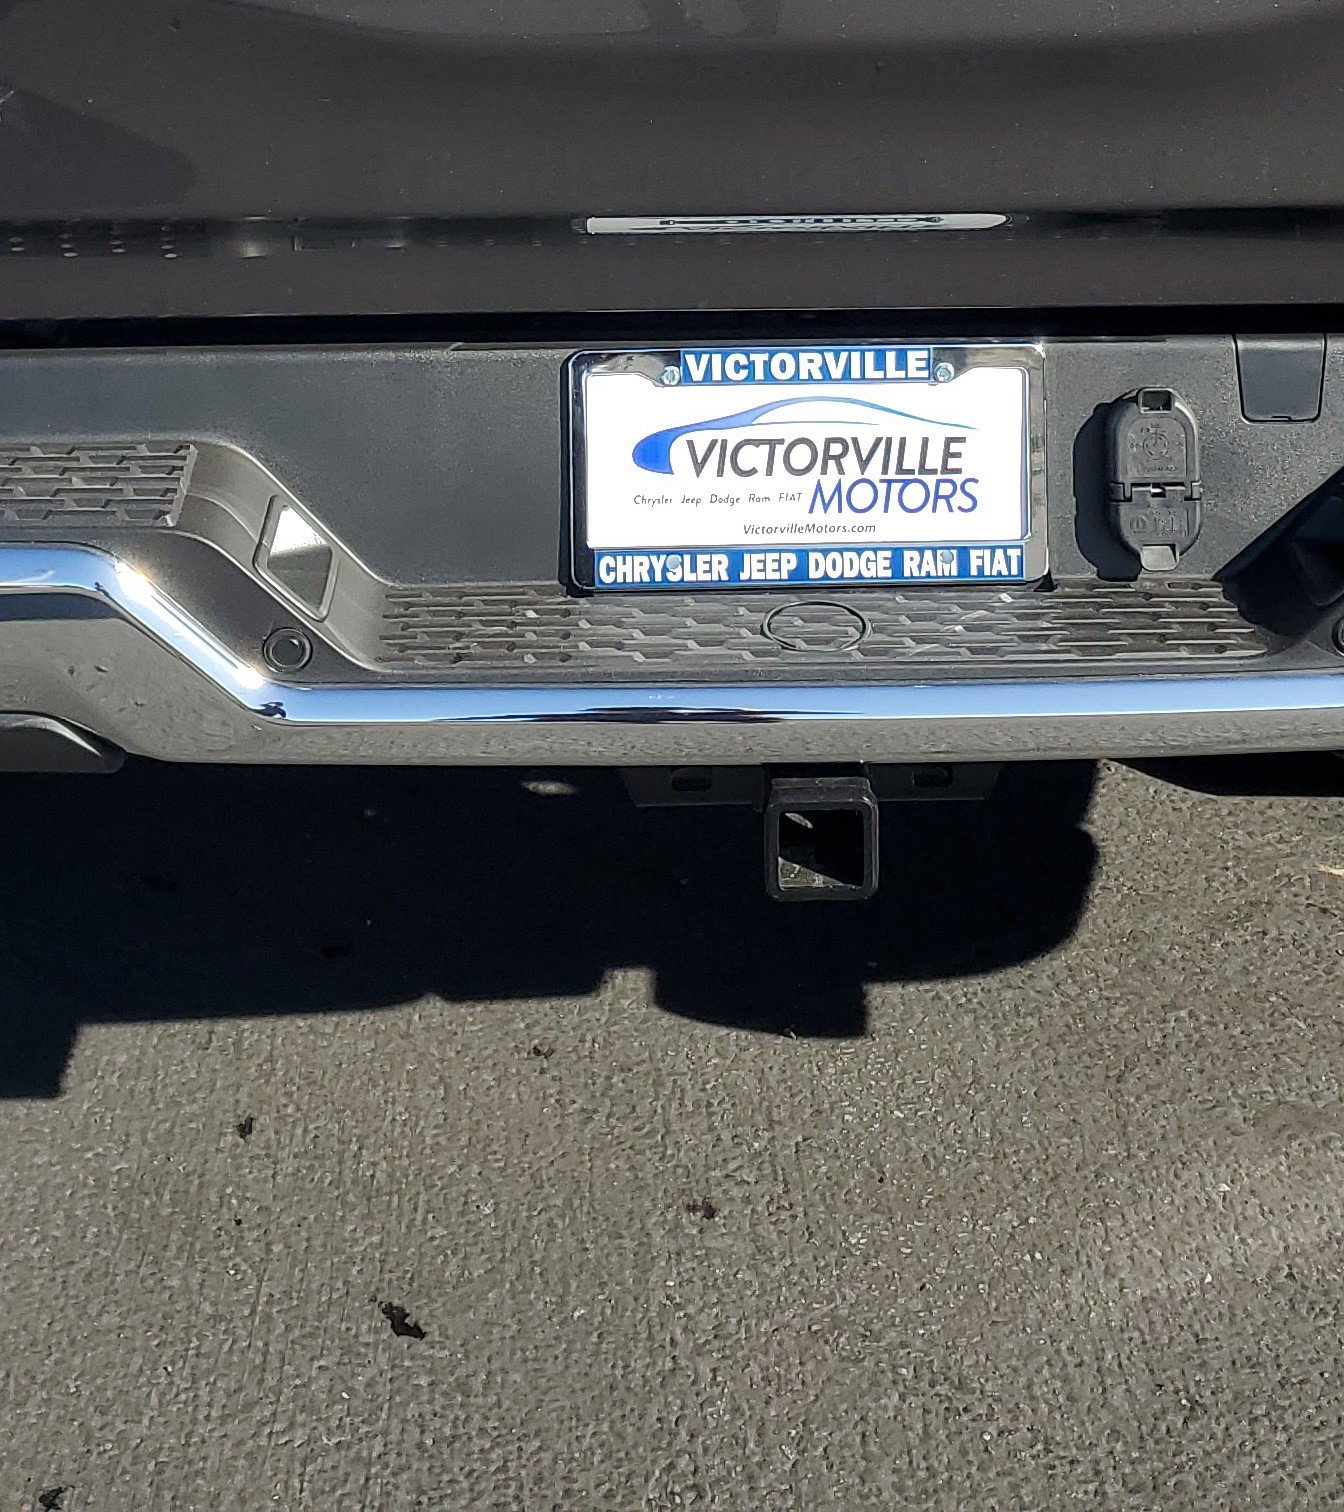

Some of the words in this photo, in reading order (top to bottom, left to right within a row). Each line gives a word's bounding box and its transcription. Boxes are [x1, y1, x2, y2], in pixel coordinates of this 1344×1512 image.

[685, 351, 930, 382] VICTORVILLE
[686, 437, 966, 478] VICTORVILLE
[633, 495, 673, 507] Chrysler
[680, 495, 702, 507] Jeep
[709, 494, 741, 506] Dodge
[748, 494, 770, 503] Ram
[778, 492, 803, 502] FIAT
[808, 477, 979, 514] MOTORS
[743, 523, 876, 535] VictorvilleMotors.com
[599, 554, 730, 584] CHRYSLER
[739, 552, 798, 581] JEEP
[808, 550, 893, 579] DODGE
[903, 549, 959, 578] RAM
[969, 548, 1022, 577] FIAT
